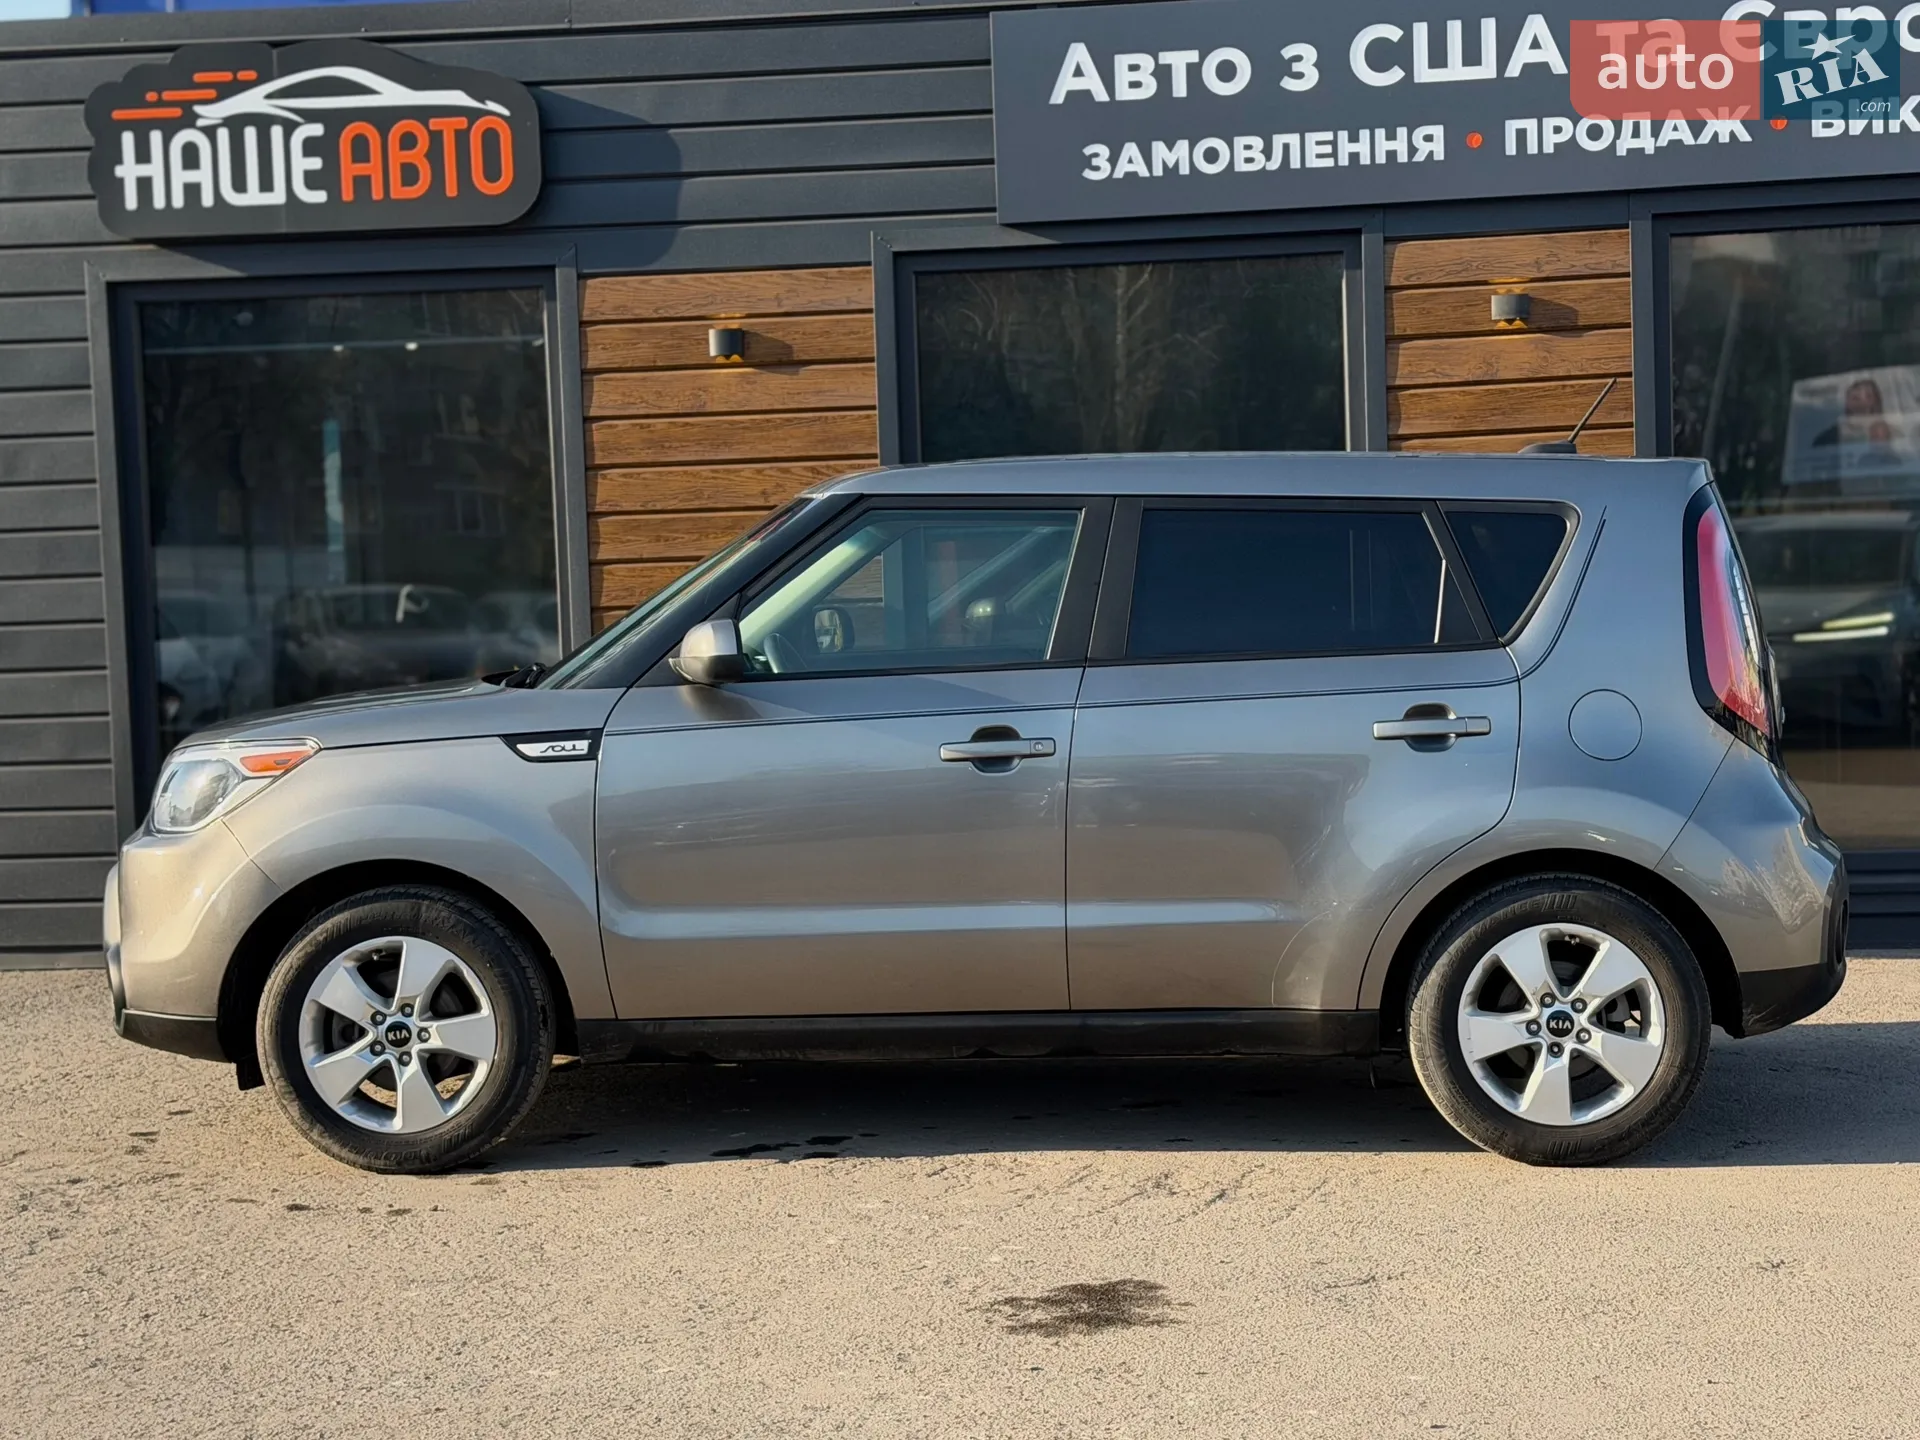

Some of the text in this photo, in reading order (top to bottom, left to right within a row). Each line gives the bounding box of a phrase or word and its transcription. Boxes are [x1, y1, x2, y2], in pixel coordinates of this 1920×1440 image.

[1050, 43, 1252, 105] Авто
[1279, 43, 1320, 92] з
[1349, 14, 1569, 87] США
[1596, 19, 1686, 69] та
[114, 116, 514, 211] НАШЕ АВТО
[1082, 125, 1445, 181] ЗАМОВЛЕННЯ
[1504, 105, 1753, 156] ПРОДАЖ
[387, 1028, 410, 1041] KIA
[1549, 1018, 1572, 1030] KIA
